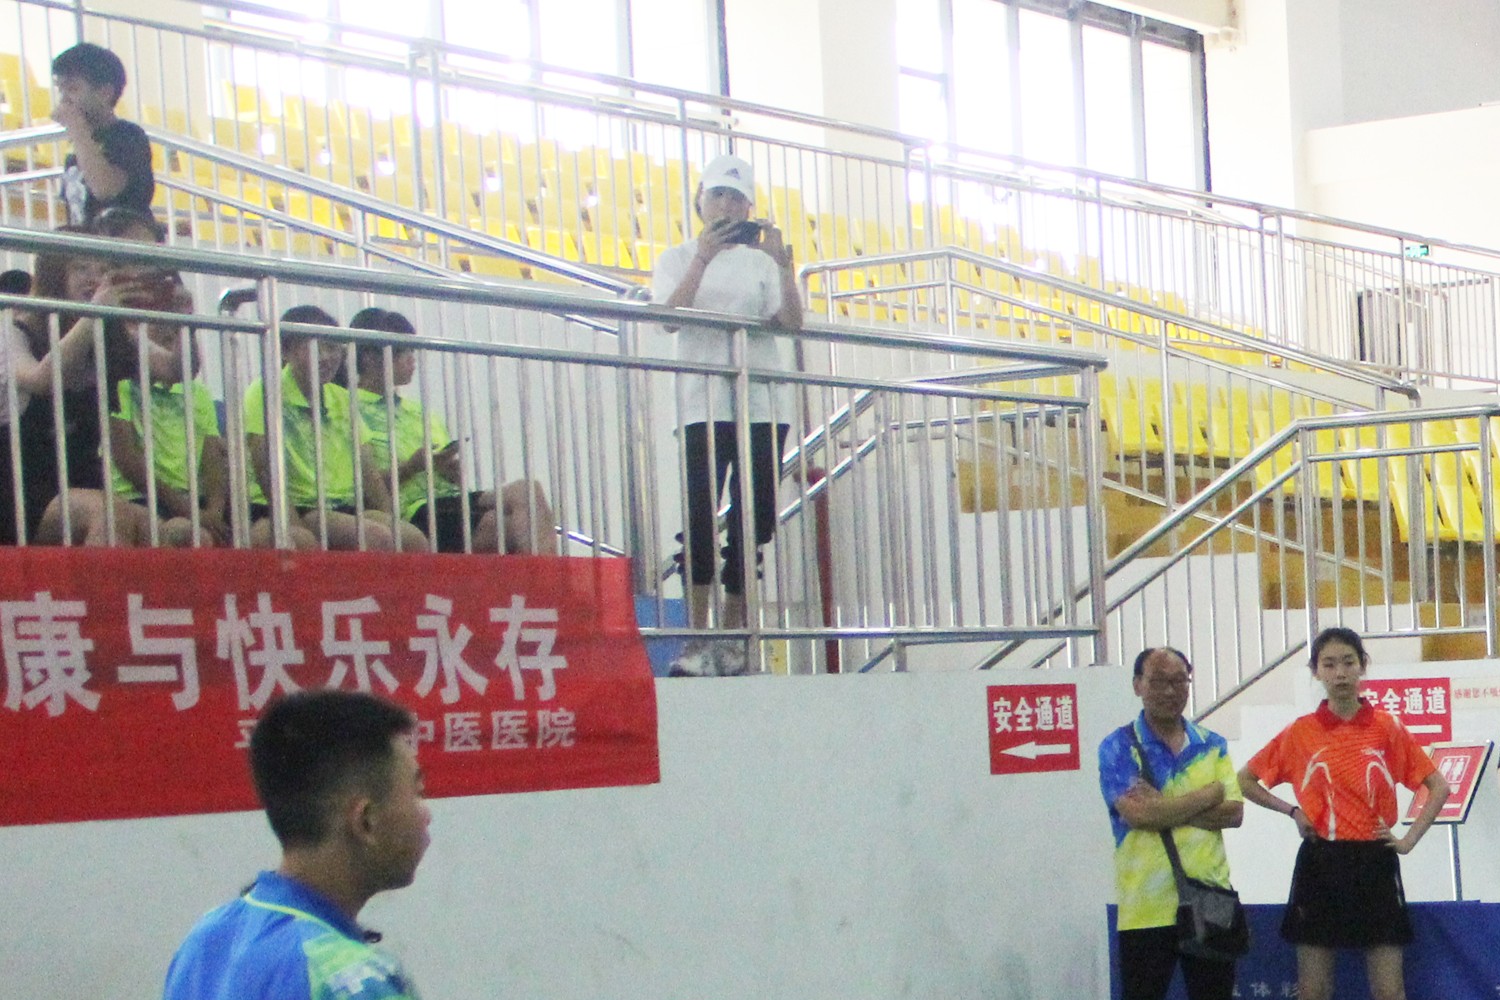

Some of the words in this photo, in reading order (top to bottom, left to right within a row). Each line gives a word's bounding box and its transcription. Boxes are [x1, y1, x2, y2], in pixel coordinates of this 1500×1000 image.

[0, 591, 568, 716] 康与快乐永存
[993, 696, 1075, 733] 安全通道
